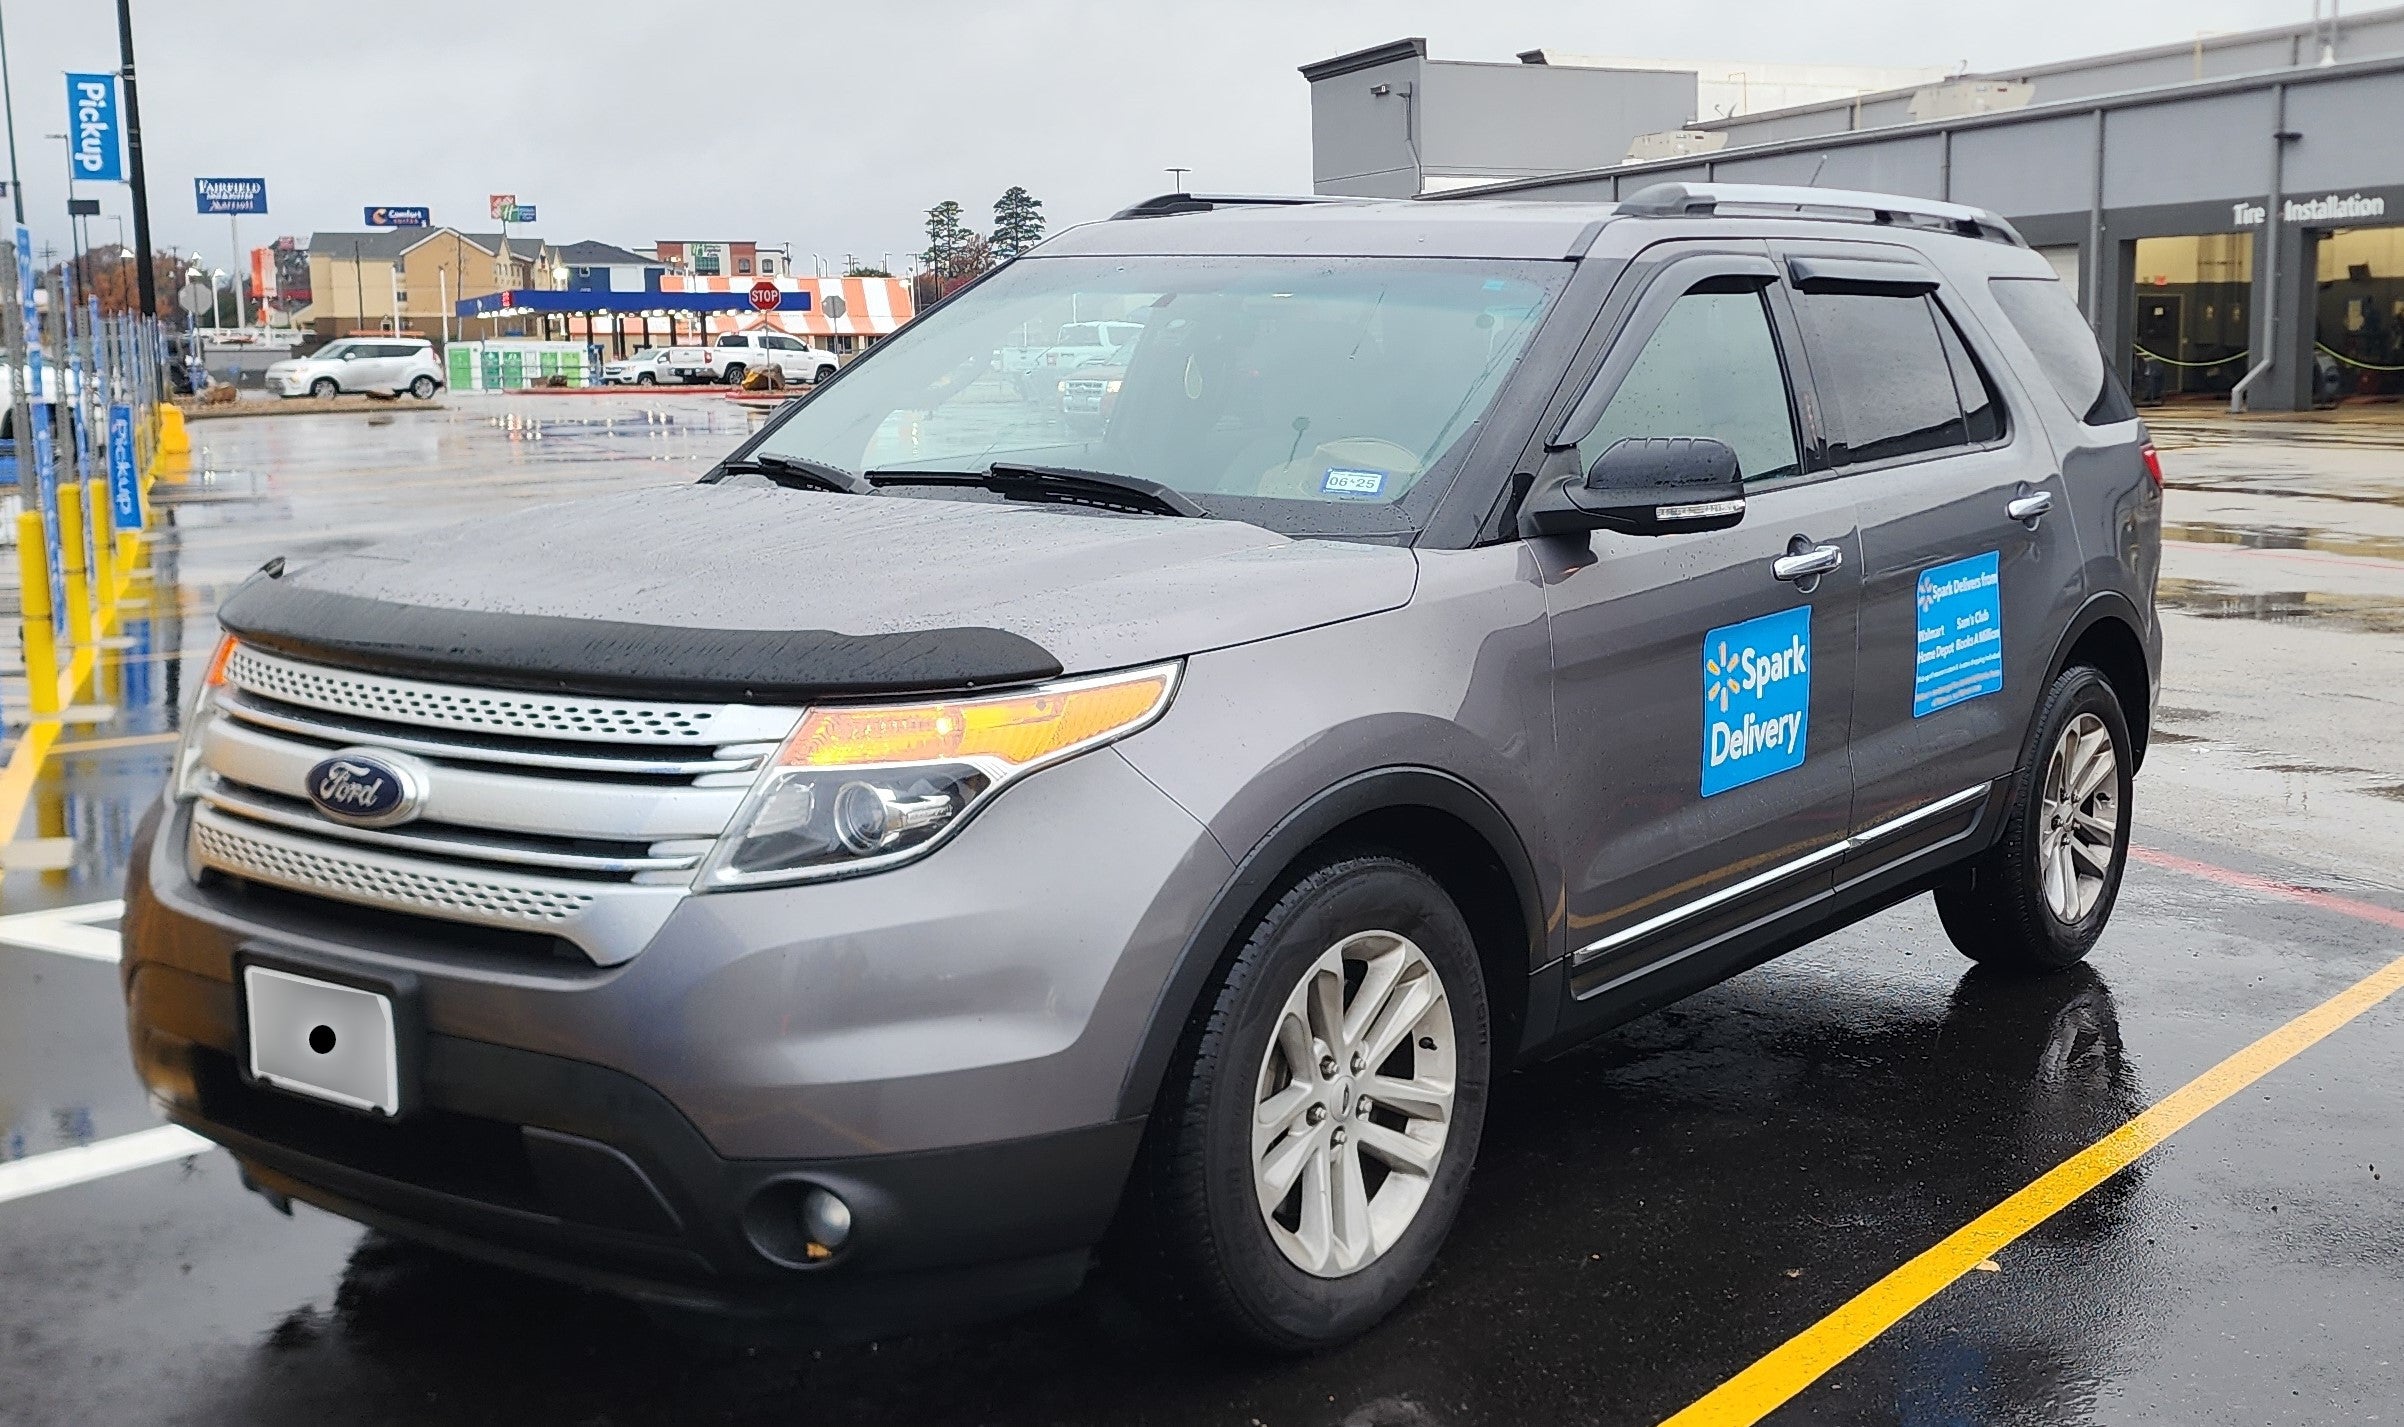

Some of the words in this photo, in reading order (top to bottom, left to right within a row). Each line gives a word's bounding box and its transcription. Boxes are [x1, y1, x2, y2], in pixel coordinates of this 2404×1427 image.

[74, 82, 110, 172] Pickup
[2233, 202, 2266, 225] Tire
[2284, 192, 2385, 222] Installation
[751, 289, 779, 303] STOP
[1932, 580, 1954, 603] Spark
[1741, 634, 1807, 700] Spark
[1710, 711, 1802, 767] Delivery
[320, 761, 384, 808] Ford
